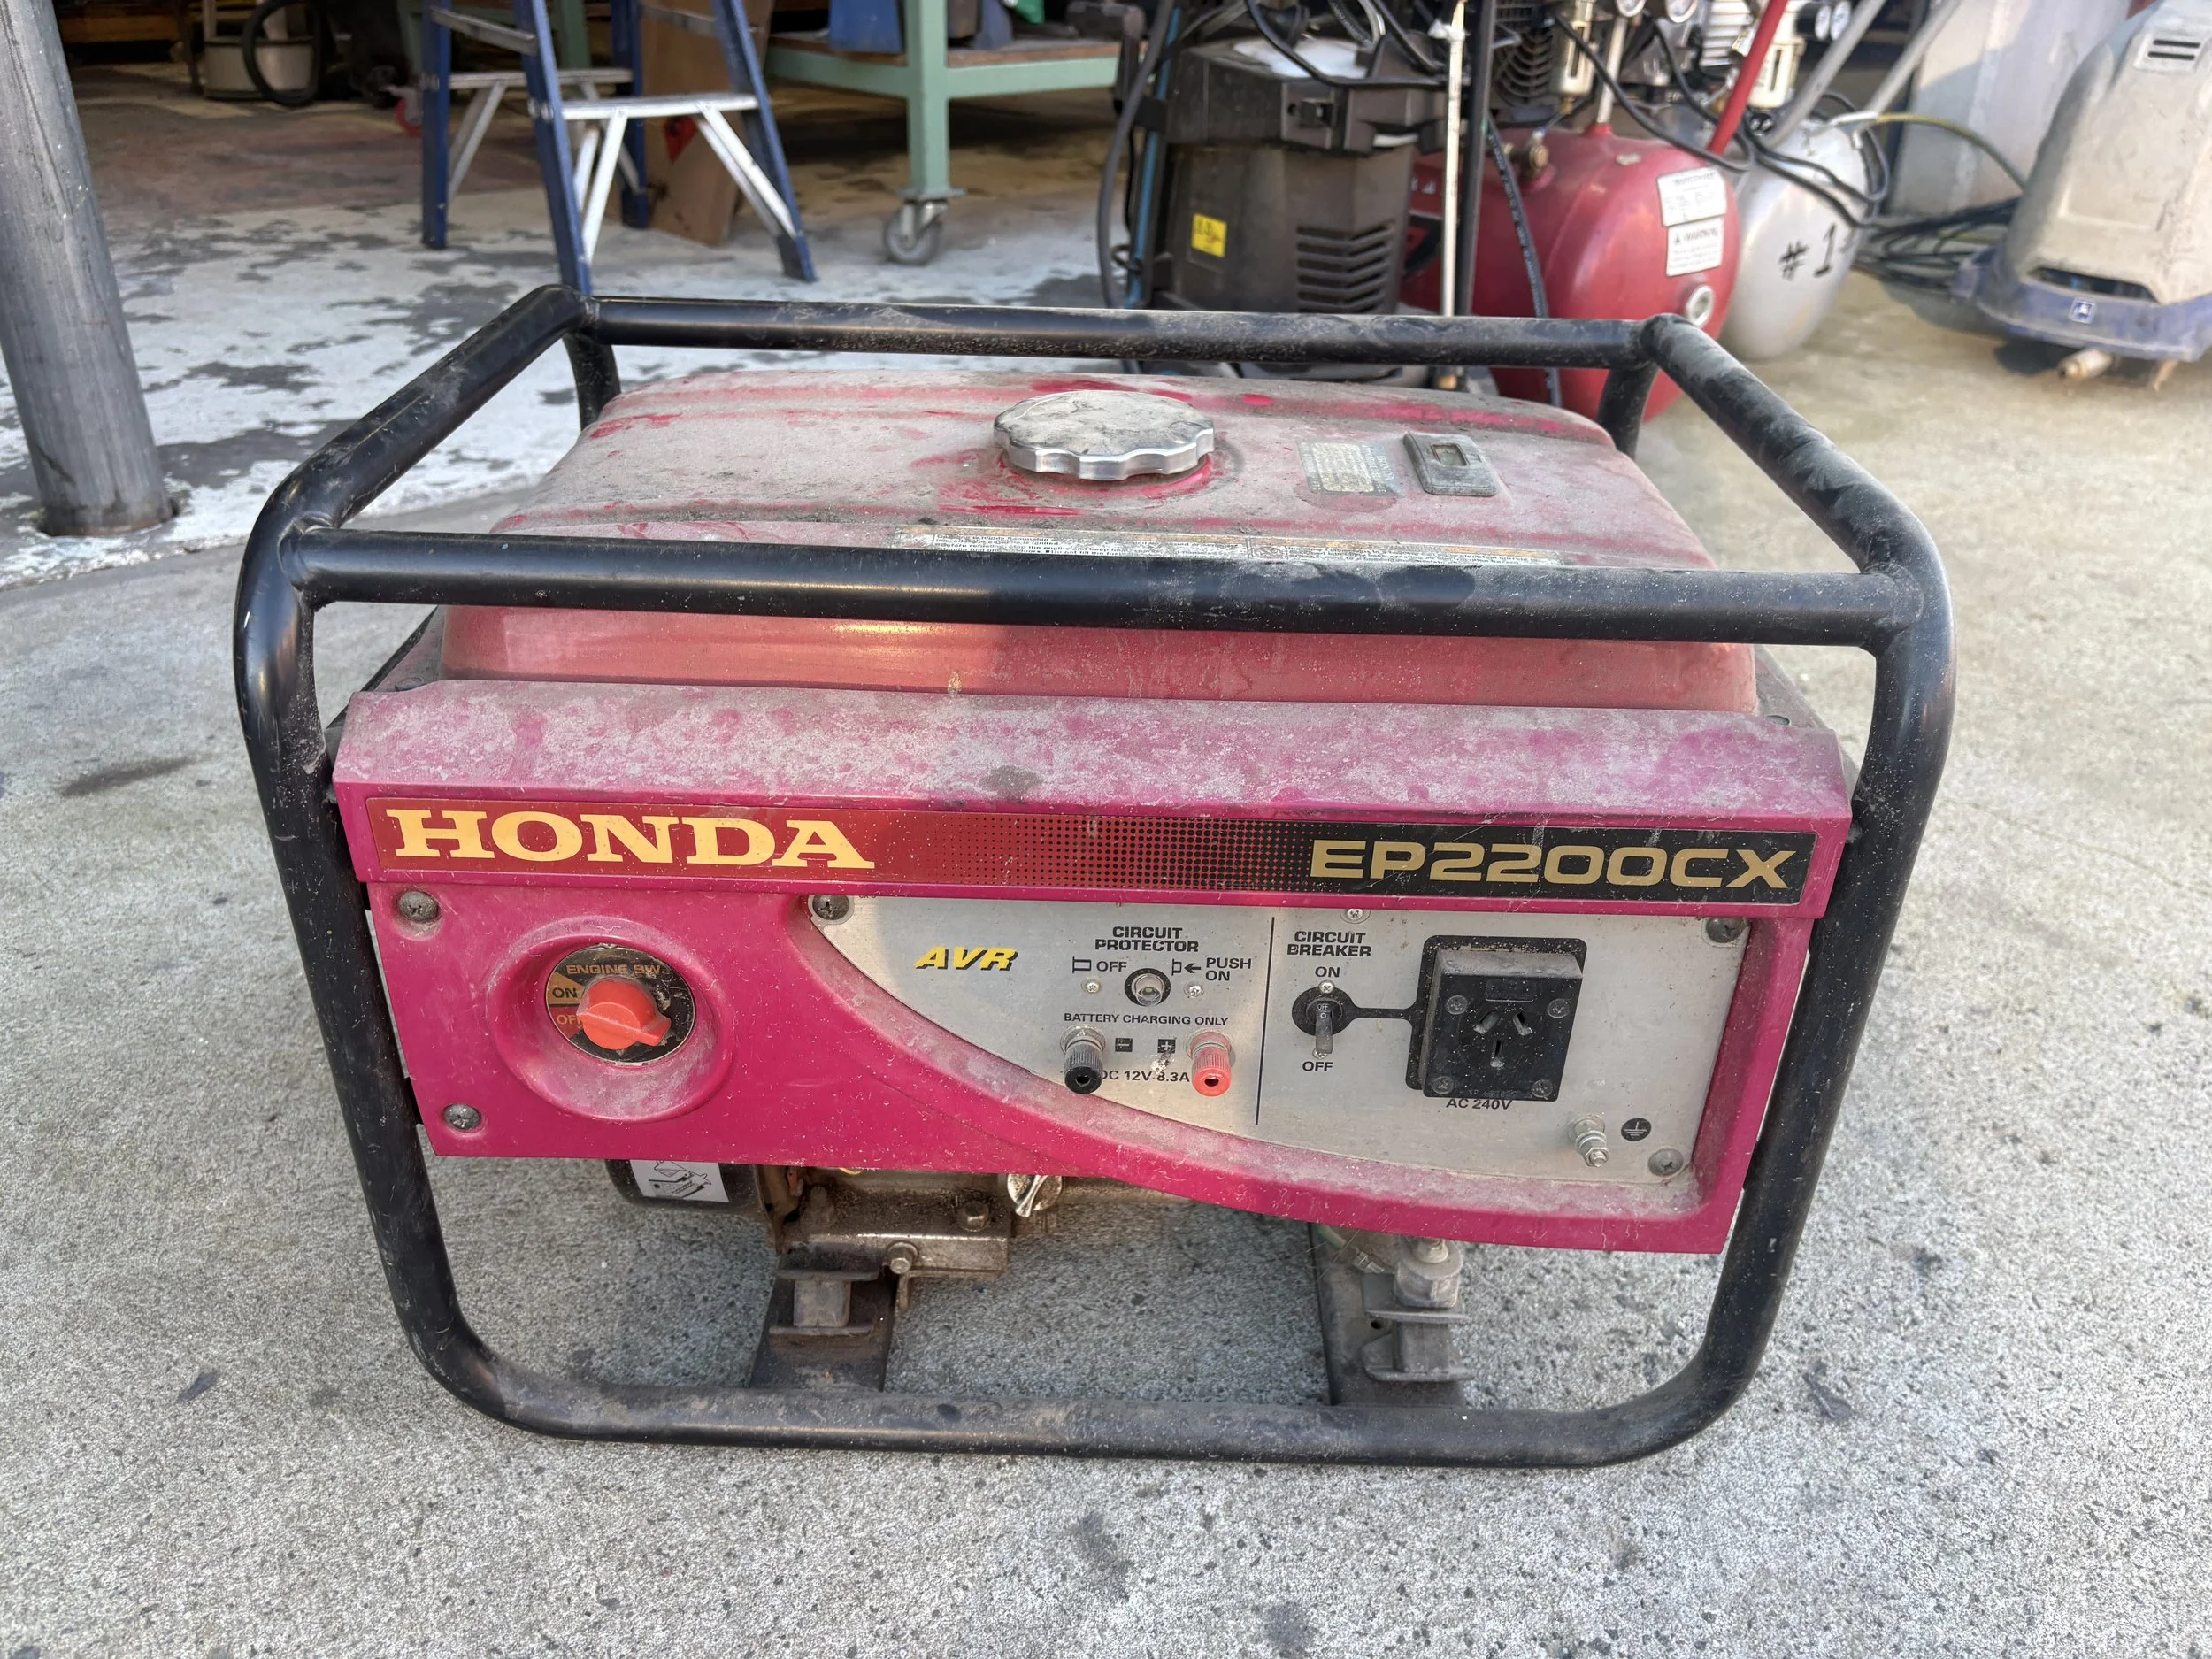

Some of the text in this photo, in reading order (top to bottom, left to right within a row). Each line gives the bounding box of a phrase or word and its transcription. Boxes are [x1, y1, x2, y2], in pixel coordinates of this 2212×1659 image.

[386, 809, 875, 869] HONDA
[1310, 840, 1796, 889] EP2200CX
[1112, 926, 1183, 940] CIRCUIT
[1294, 931, 1366, 945] CIRCUIT
[1094, 939, 1199, 953] PROTECTOR
[1286, 943, 1371, 958] BREAKER
[914, 946, 1018, 971] AVR
[1206, 956, 1251, 970] PUSH
[566, 964, 627, 974] ENGINE
[1096, 960, 1127, 972] OFF
[1315, 965, 1340, 979] ON
[1205, 970, 1230, 982] ON
[552, 987, 578, 998] ON
[1064, 1013, 1228, 1026] BATTERY CHARGING ONLY
[1302, 1061, 1333, 1072] OFF
[1446, 1098, 1513, 1110] AC 240V
